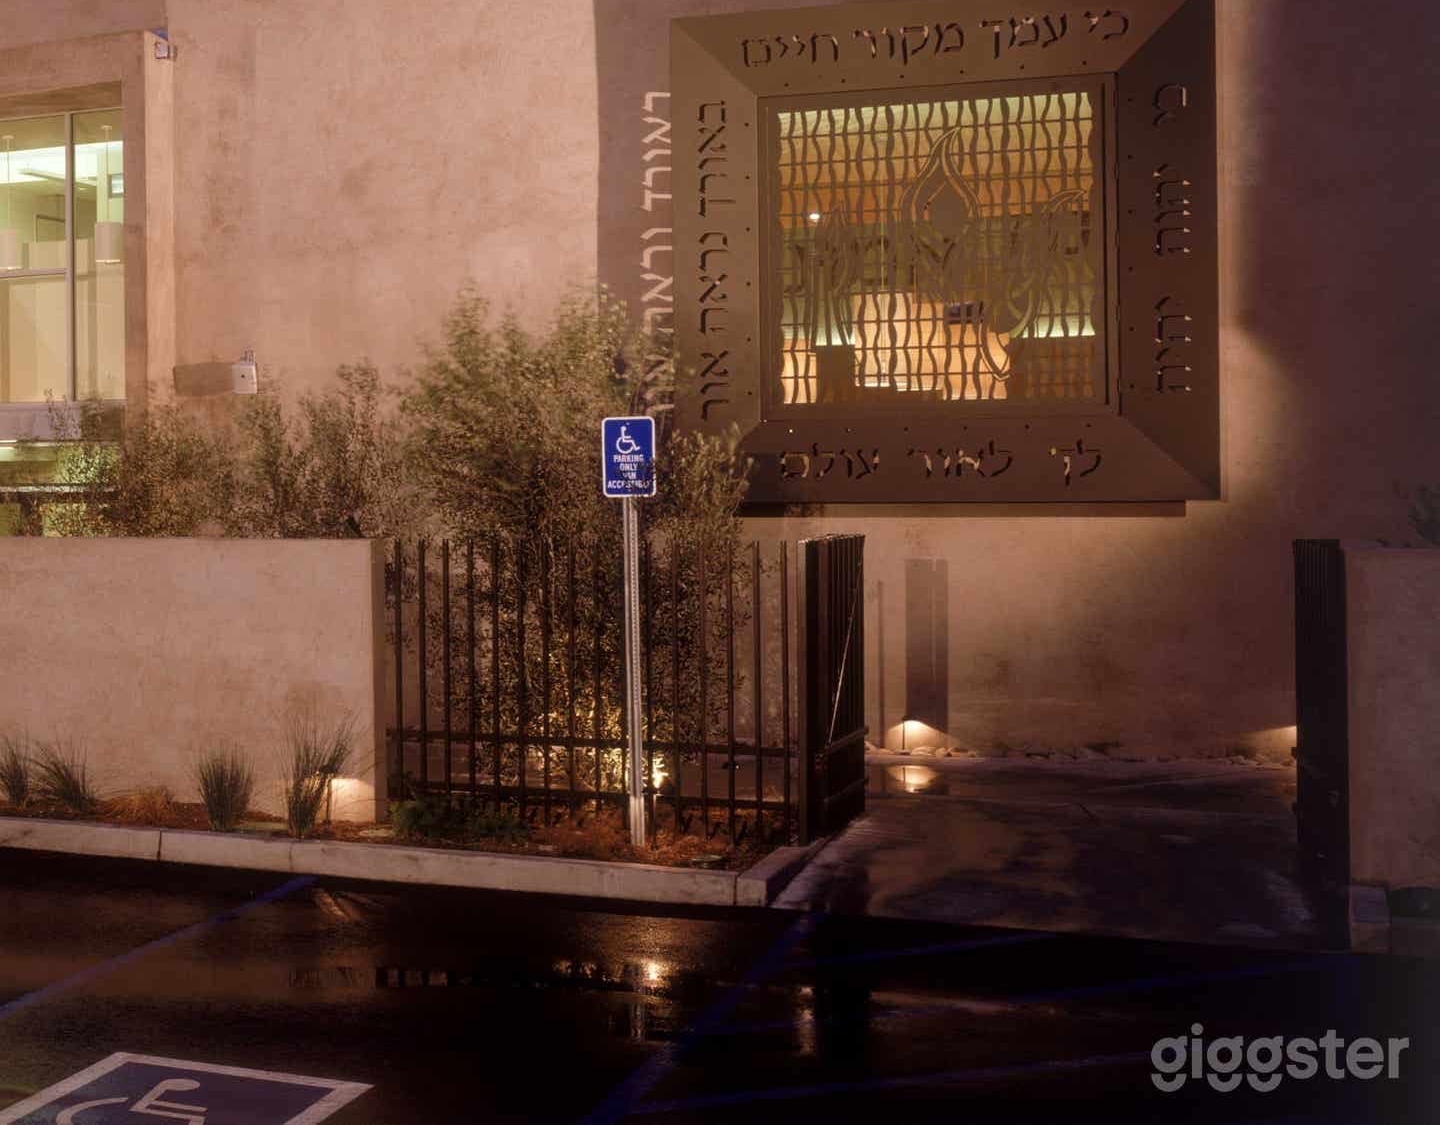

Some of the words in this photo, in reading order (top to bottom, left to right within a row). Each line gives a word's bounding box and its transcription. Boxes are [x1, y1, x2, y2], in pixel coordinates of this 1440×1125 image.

[978, 12, 1068, 59] עמך
[1083, 9, 1130, 40] כי
[740, 32, 840, 68] חיים
[851, 22, 965, 66] מקור
[613, 454, 645, 463] PARKING
[619, 463, 638, 471] ONLY
